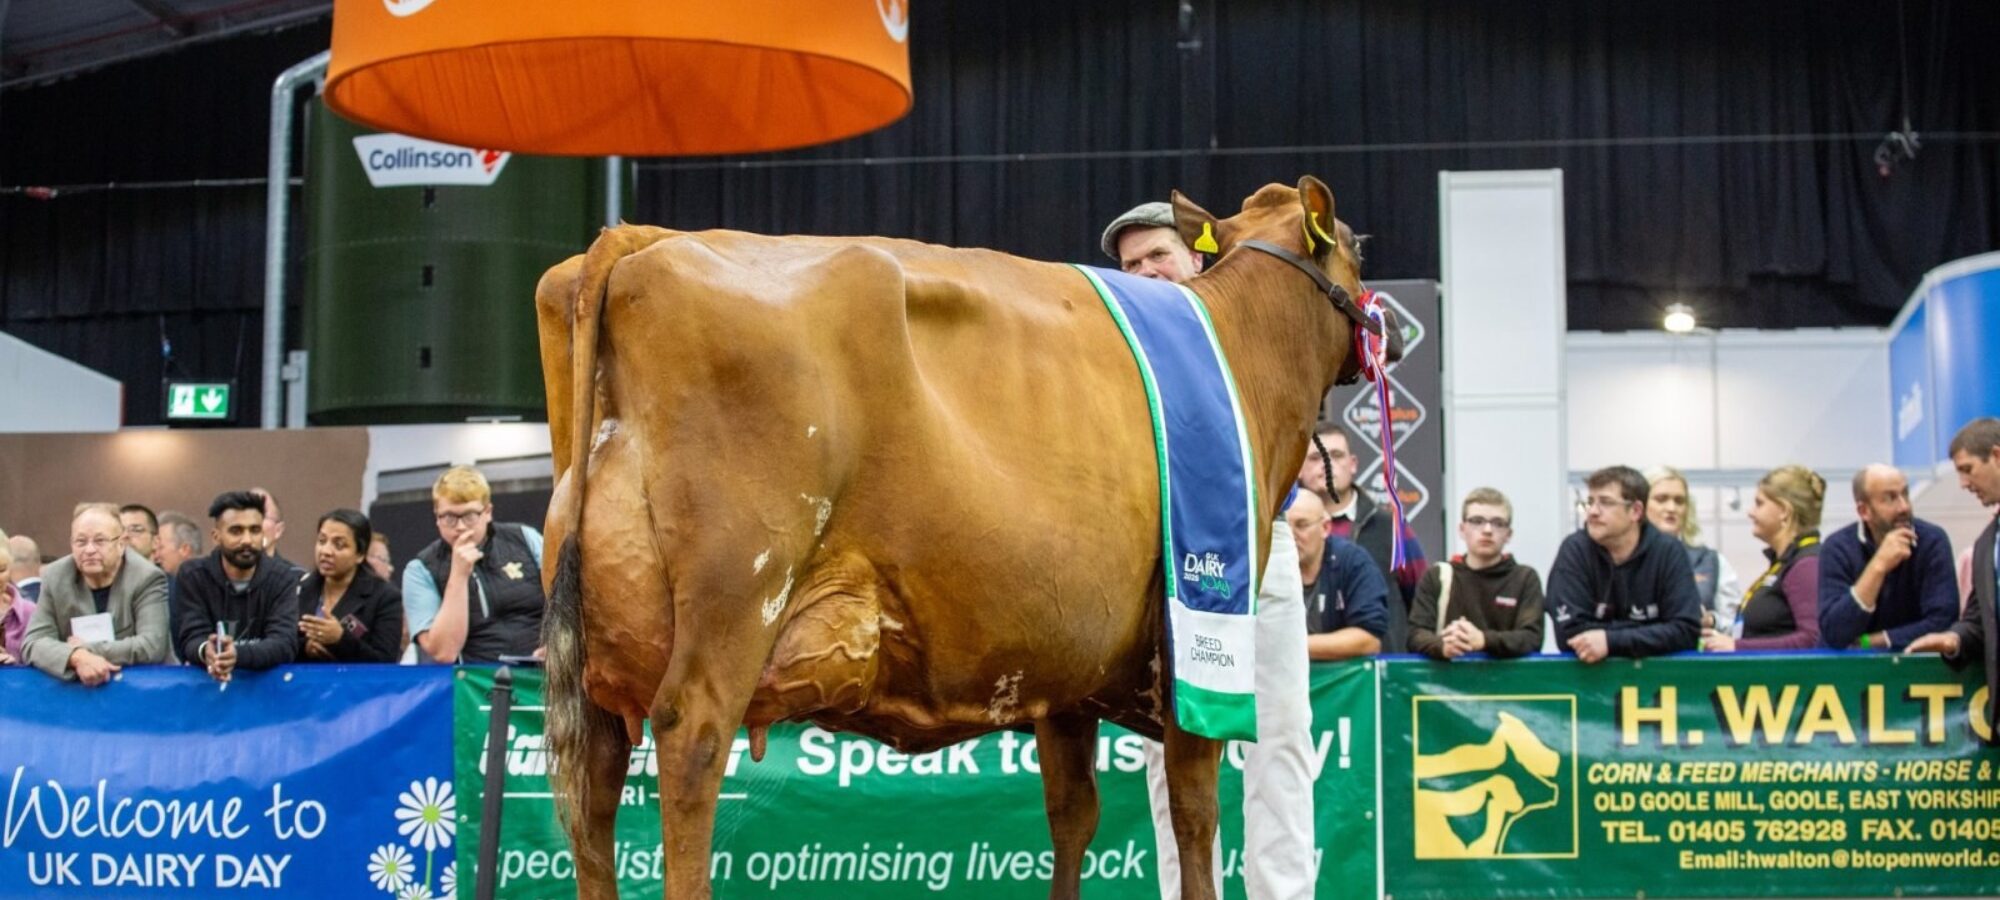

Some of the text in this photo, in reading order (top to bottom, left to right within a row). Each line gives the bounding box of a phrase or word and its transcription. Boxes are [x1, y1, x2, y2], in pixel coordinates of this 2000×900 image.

[369, 147, 472, 170] Collinson
[1184, 553, 1225, 578] DAIRY
[1194, 634, 1222, 652] BREED
[1190, 647, 1235, 667] CHAMPION
[1620, 685, 1704, 745] H.
[797, 727, 980, 787] Speak
[1588, 762, 1652, 784] CORN
[1656, 761, 1673, 784] &
[1677, 761, 1736, 784] FEED
[1740, 760, 1879, 783] MERCHANTS
[1895, 760, 1972, 782] HORSE
[1976, 760, 1992, 781] &
[4, 765, 327, 848] Welcome to
[1594, 792, 1635, 812] OLD
[1640, 791, 1710, 812] GOOLE
[1715, 791, 1765, 813] MILL,
[1769, 791, 1845, 813] GOOLE,
[1850, 790, 1901, 810] EAST
[1601, 820, 1661, 843] TEL.
[1669, 820, 1746, 842] 01405
[1754, 820, 1847, 842] 762928
[1861, 819, 1922, 841] FAX.
[28, 851, 292, 888] UK DAIRY DAY
[746, 842, 954, 891] optimising
[966, 840, 1148, 881] livesock
